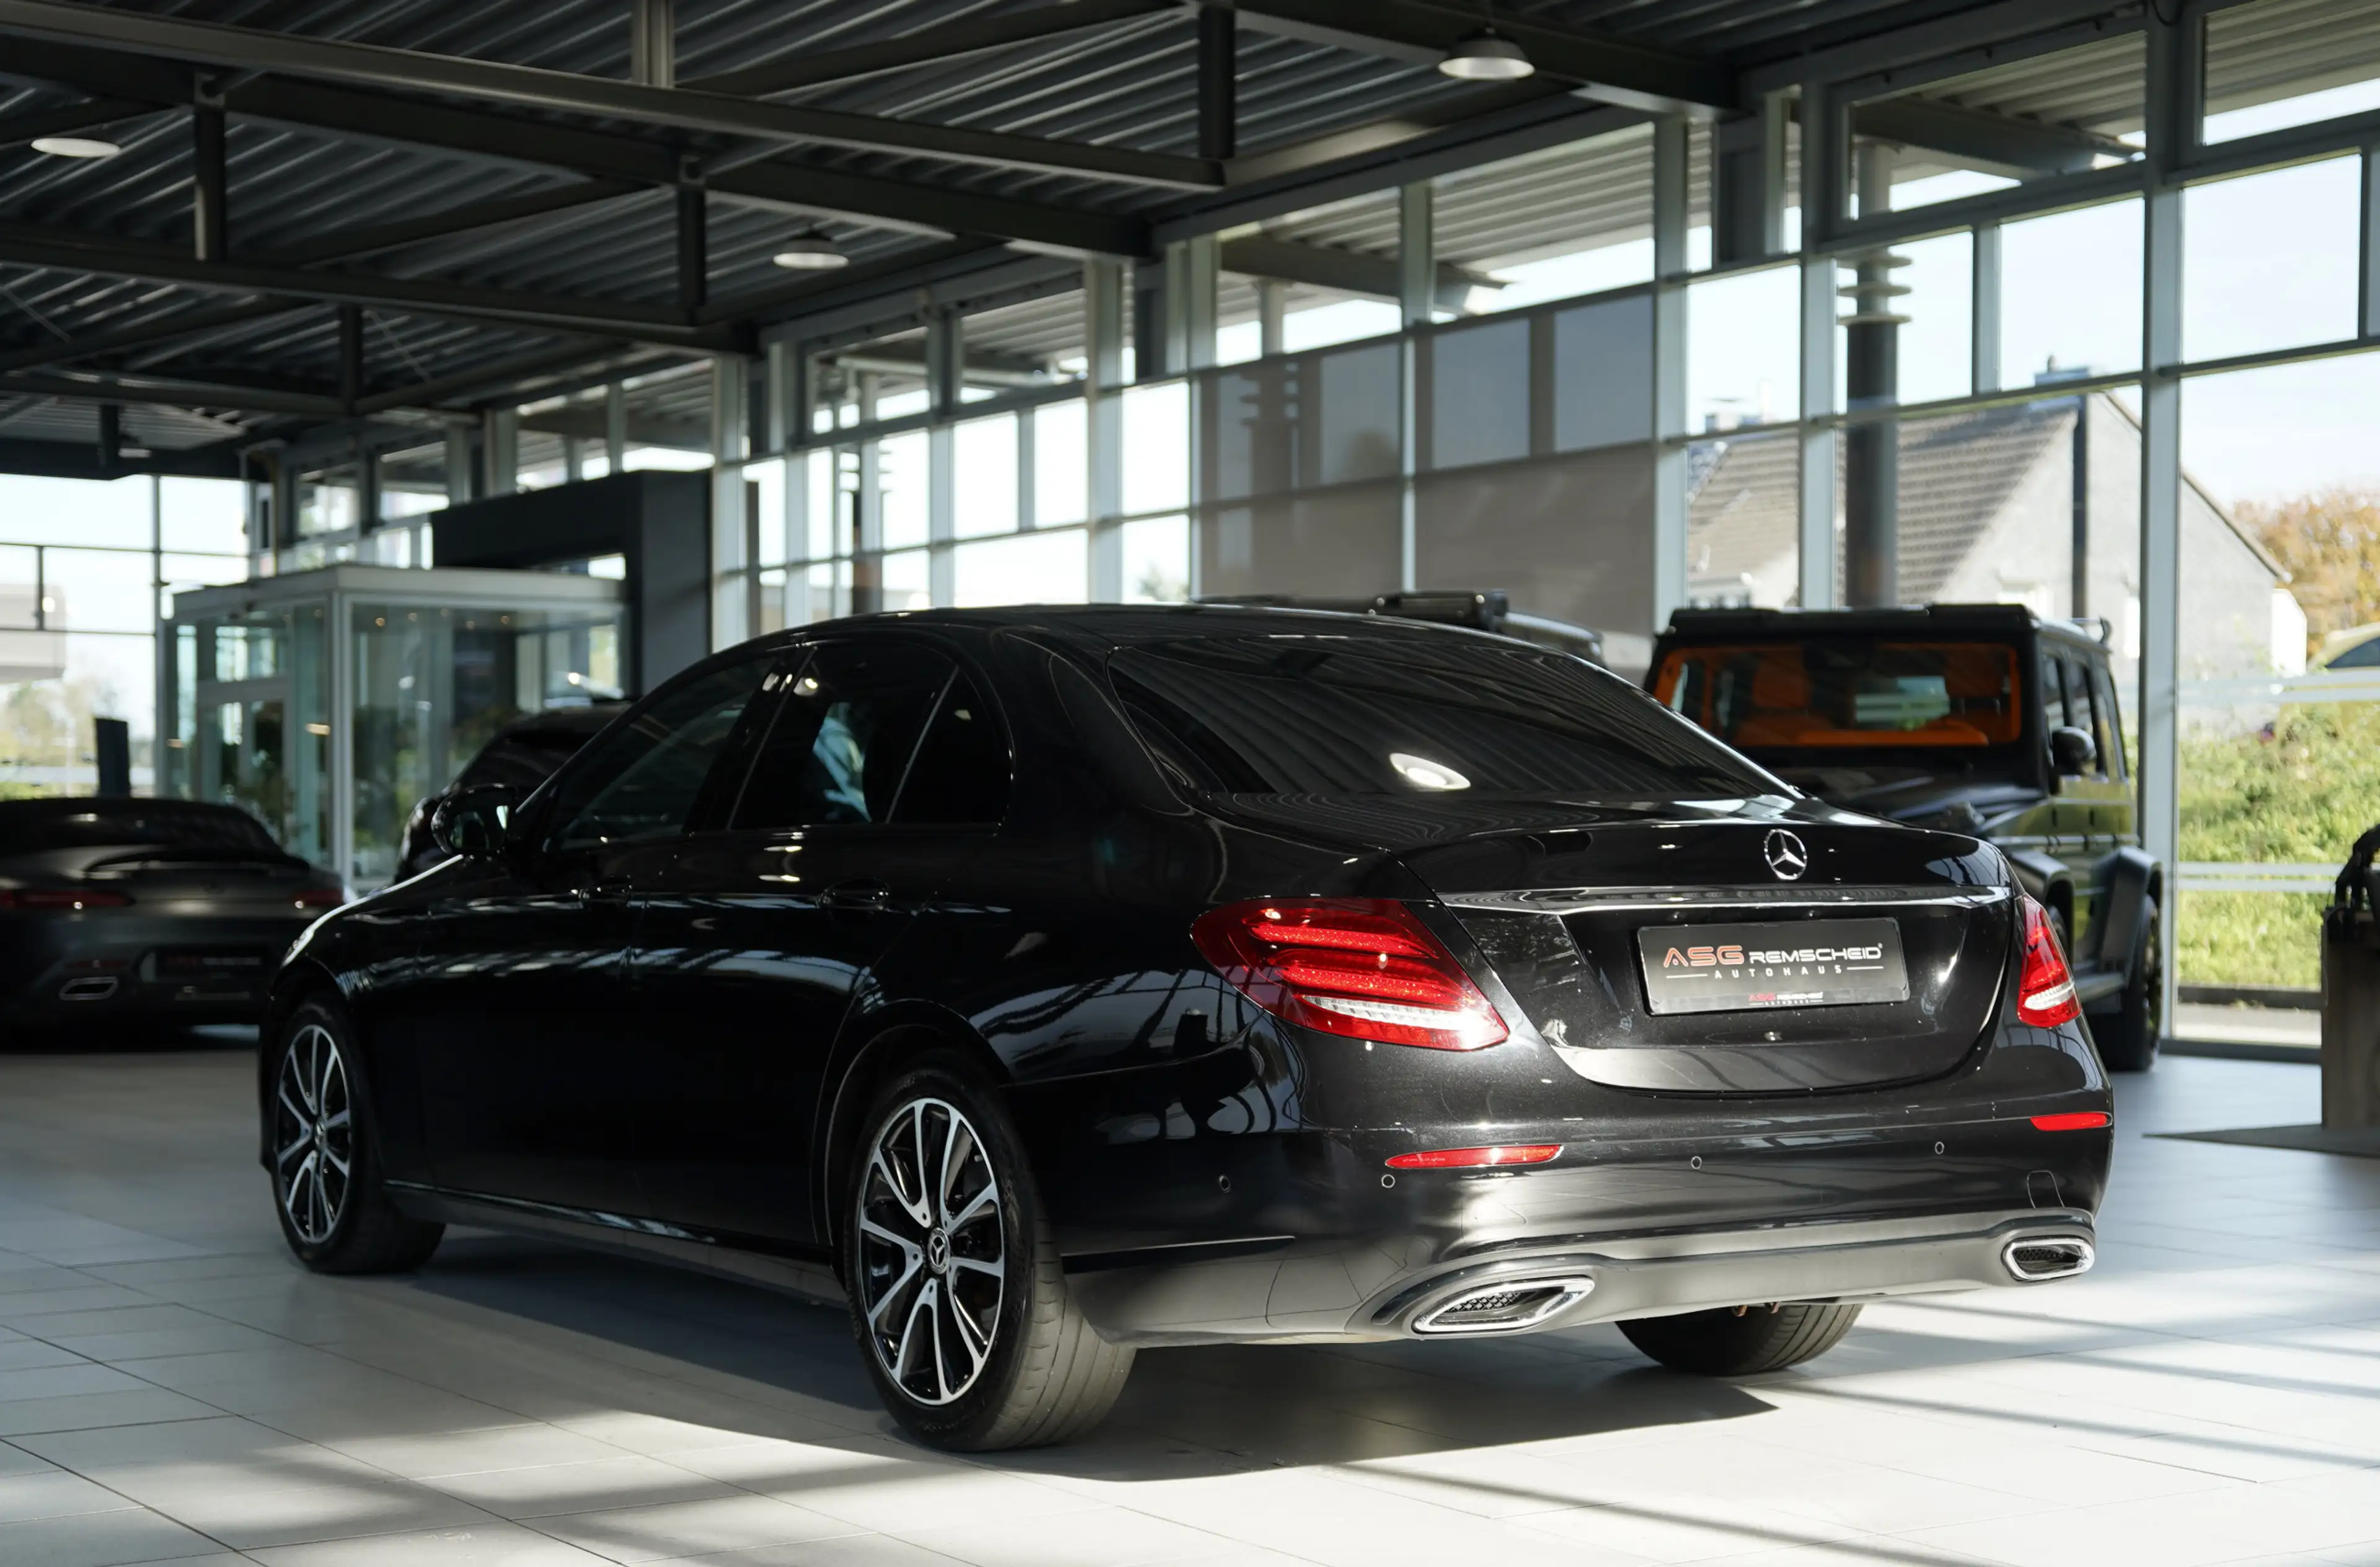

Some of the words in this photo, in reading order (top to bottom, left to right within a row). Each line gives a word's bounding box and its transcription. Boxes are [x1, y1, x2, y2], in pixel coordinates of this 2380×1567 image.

[1663, 945, 1745, 968] ASG
[1715, 964, 1842, 979] AUTOHAUS
[1749, 993, 1776, 1001] ASG
